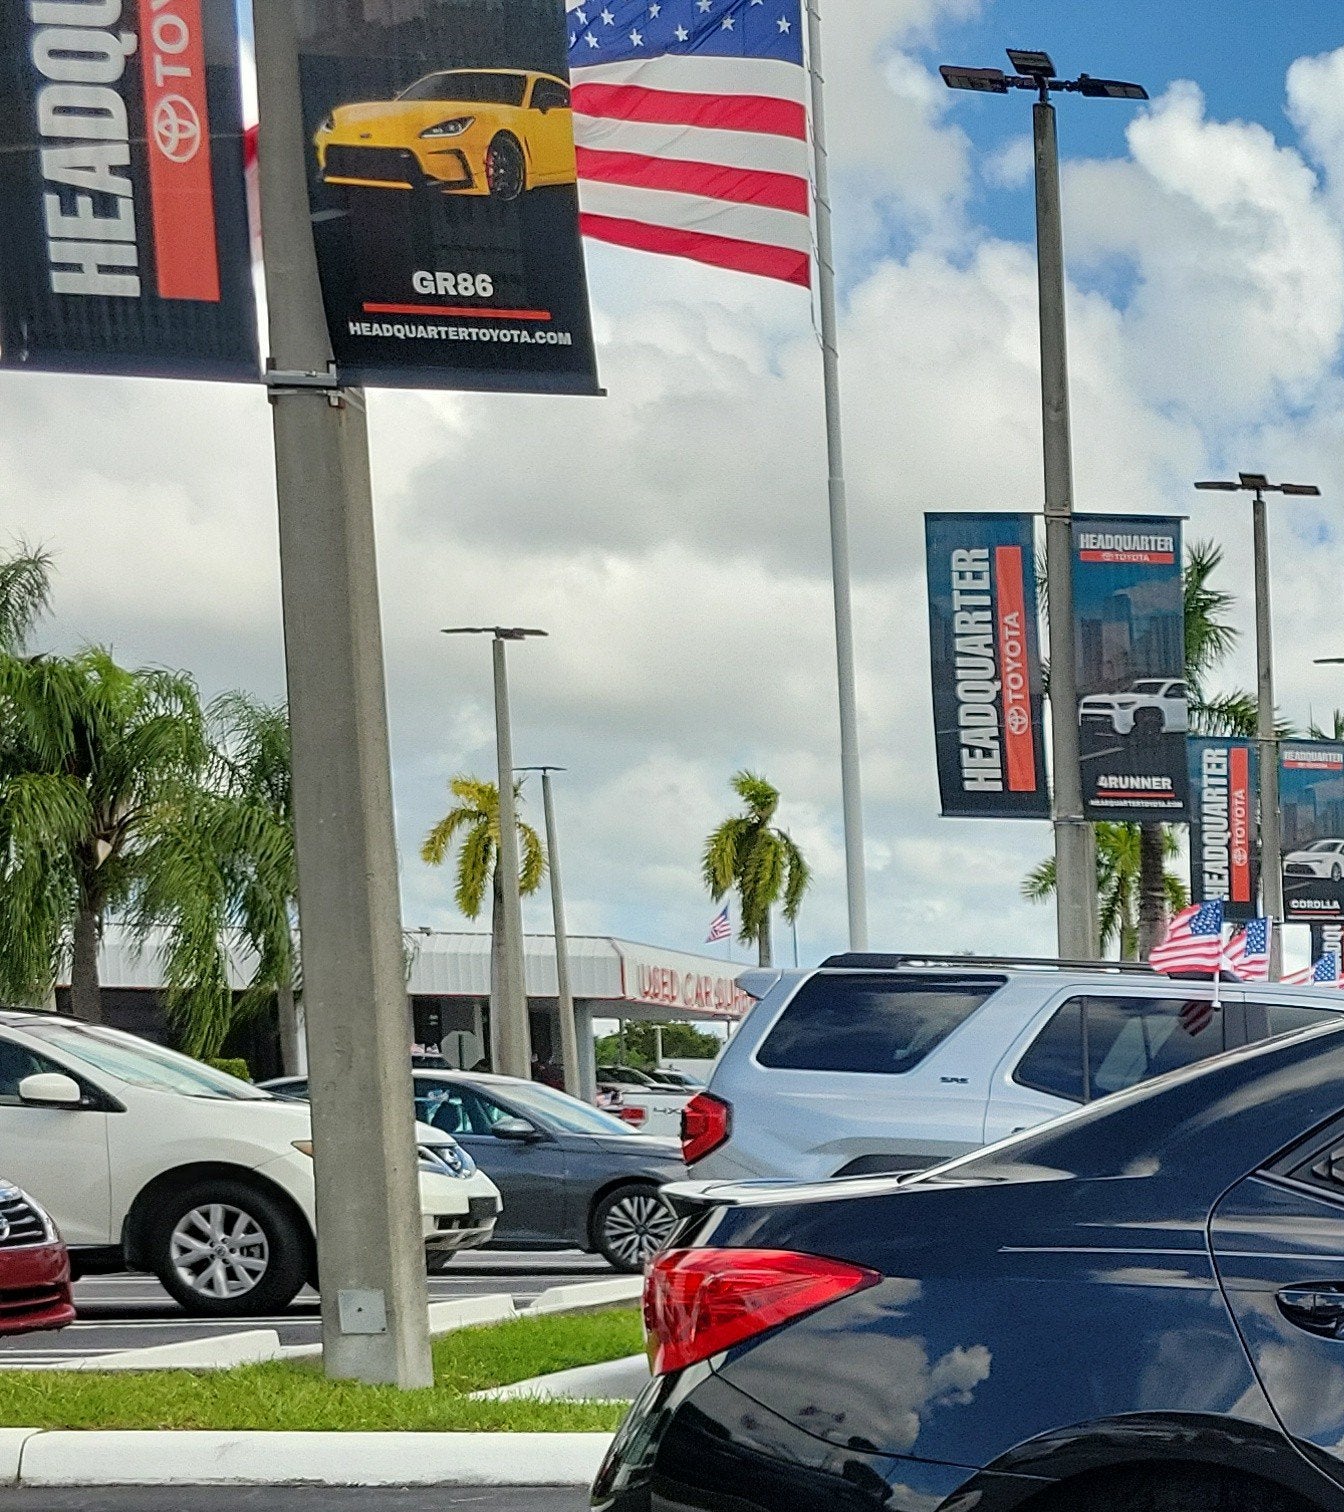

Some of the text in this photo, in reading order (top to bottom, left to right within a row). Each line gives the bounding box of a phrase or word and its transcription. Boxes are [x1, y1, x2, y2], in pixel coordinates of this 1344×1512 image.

[151, 0, 191, 87] TO
[413, 270, 494, 297] GR86
[349, 321, 572, 345] HEADQUARTERTOYOTA.COM
[1080, 533, 1174, 552] HEADQUARTER
[1115, 553, 1150, 562] TOYOTA
[951, 548, 1003, 792] HEADQUARTER
[1004, 611, 1025, 701] TOYOTA
[1097, 775, 1172, 789] 4RUNNER
[1202, 748, 1230, 901] HEADQUARTER
[1232, 789, 1247, 847] TOYOTA
[1291, 899, 1340, 910] COROLLA
[637, 964, 679, 1001] USED
[683, 972, 714, 1007] CAR
